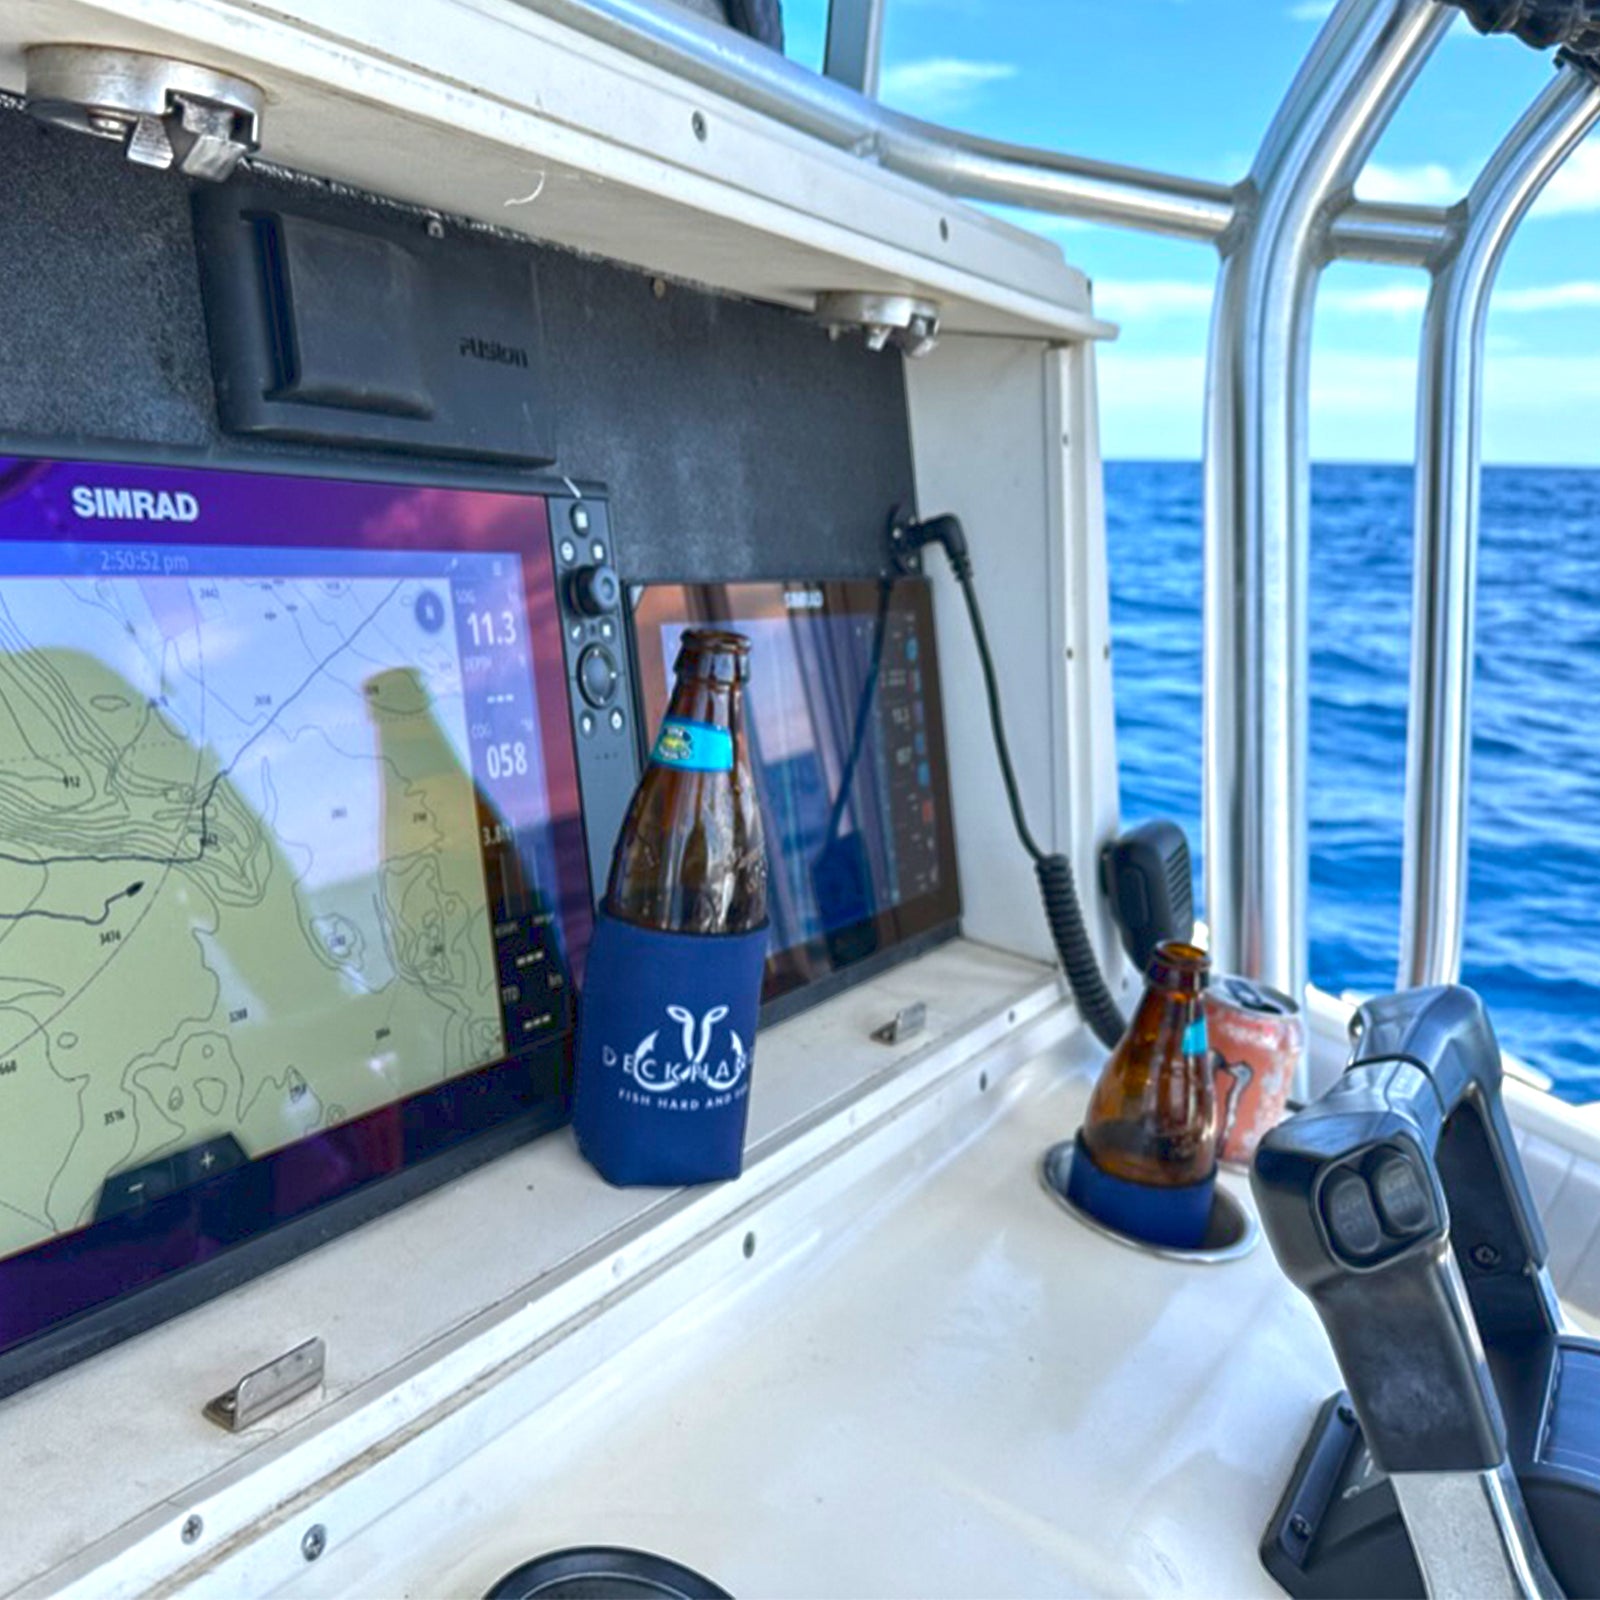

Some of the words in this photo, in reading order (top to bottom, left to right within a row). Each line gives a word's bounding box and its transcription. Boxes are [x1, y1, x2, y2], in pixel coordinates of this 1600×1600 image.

[71, 485, 200, 522] SIMRAD
[101, 551, 160, 571] 2:50:52
[163, 556, 189, 574] pm
[467, 611, 517, 646] 11.3
[486, 742, 528, 779] 058
[618, 1087, 650, 1106] FISH
[657, 1097, 700, 1111] HARD
